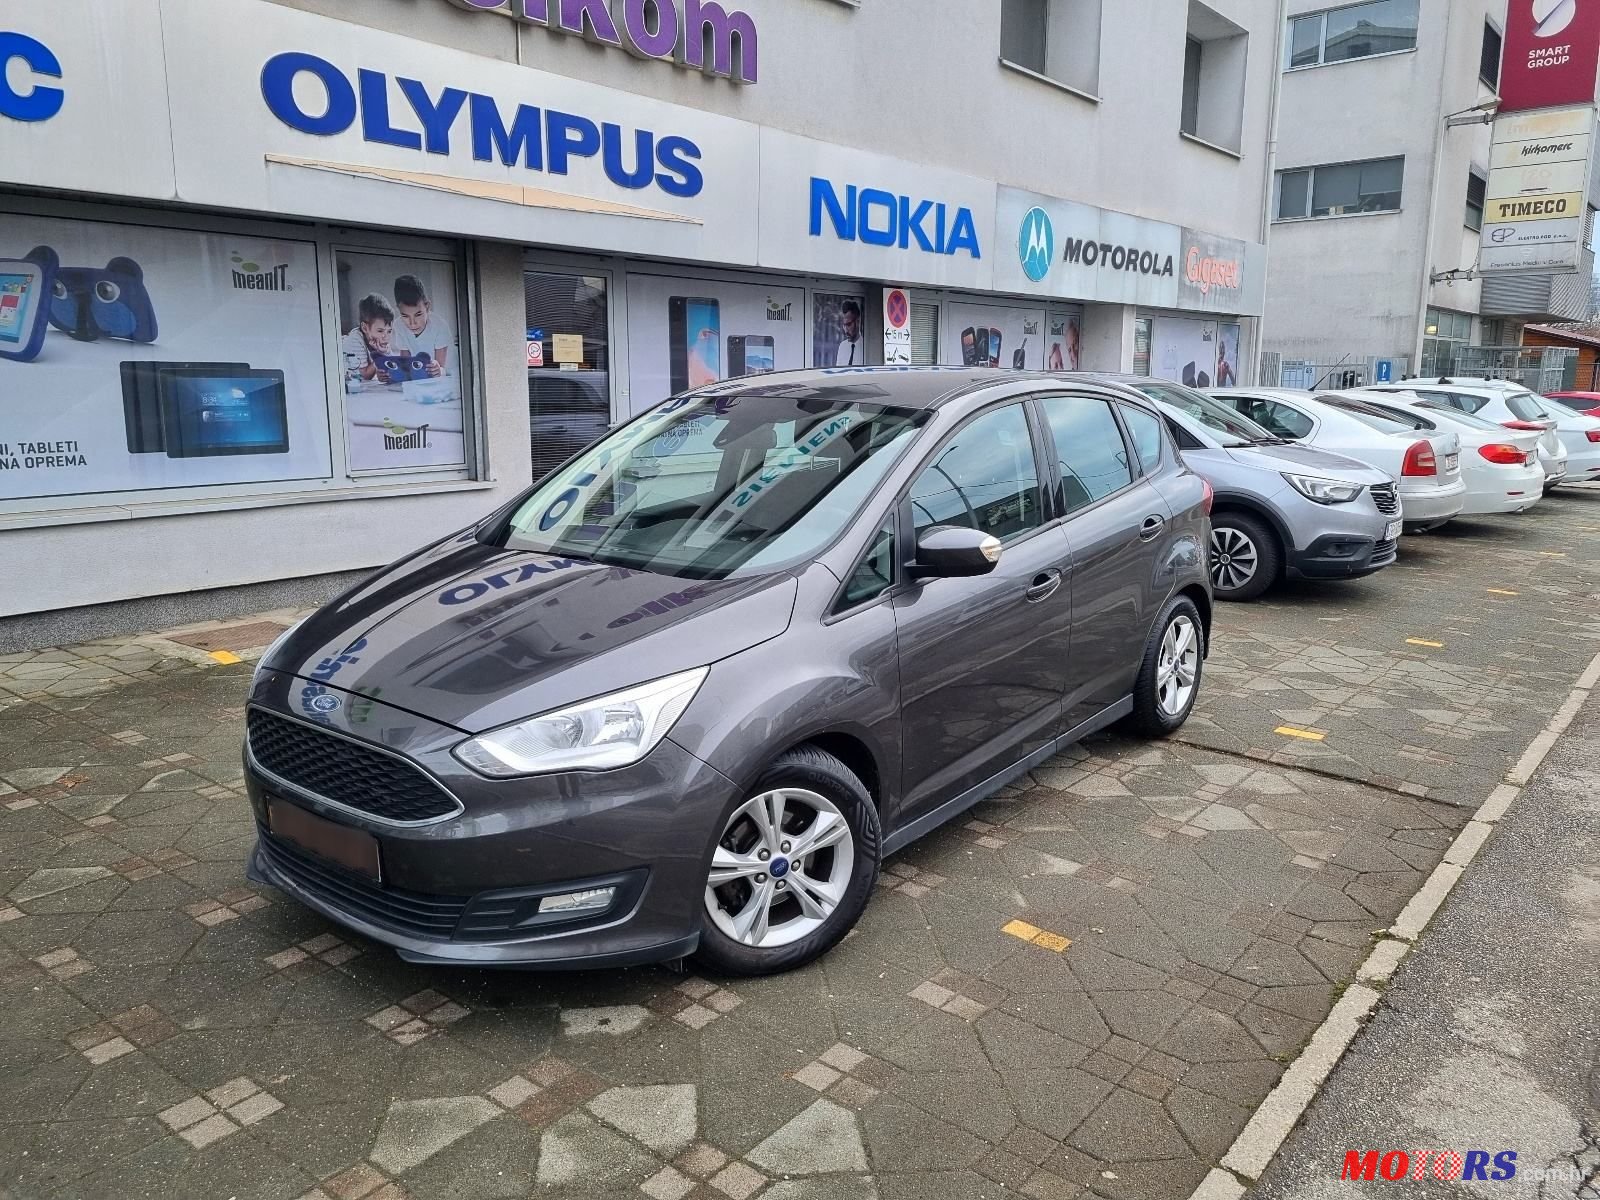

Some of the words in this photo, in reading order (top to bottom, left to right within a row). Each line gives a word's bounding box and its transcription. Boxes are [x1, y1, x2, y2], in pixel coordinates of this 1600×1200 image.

[1527, 55, 1570, 68] GROUP
[1528, 45, 1571, 59] SMART
[260, 52, 703, 197] OLYMPUS
[1521, 142, 1573, 156] kirkomerc
[809, 176, 981, 260] NOKIA
[1499, 199, 1567, 218] TIMECO
[1063, 236, 1173, 277] MOTOROLA
[231, 264, 289, 291] meanIT
[1186, 246, 1239, 294] Gigaset
[766, 302, 792, 321] meanIT
[384, 424, 429, 450] meanIT
[18, 440, 78, 455] TABLETI
[24, 454, 88, 469] OPREMA
